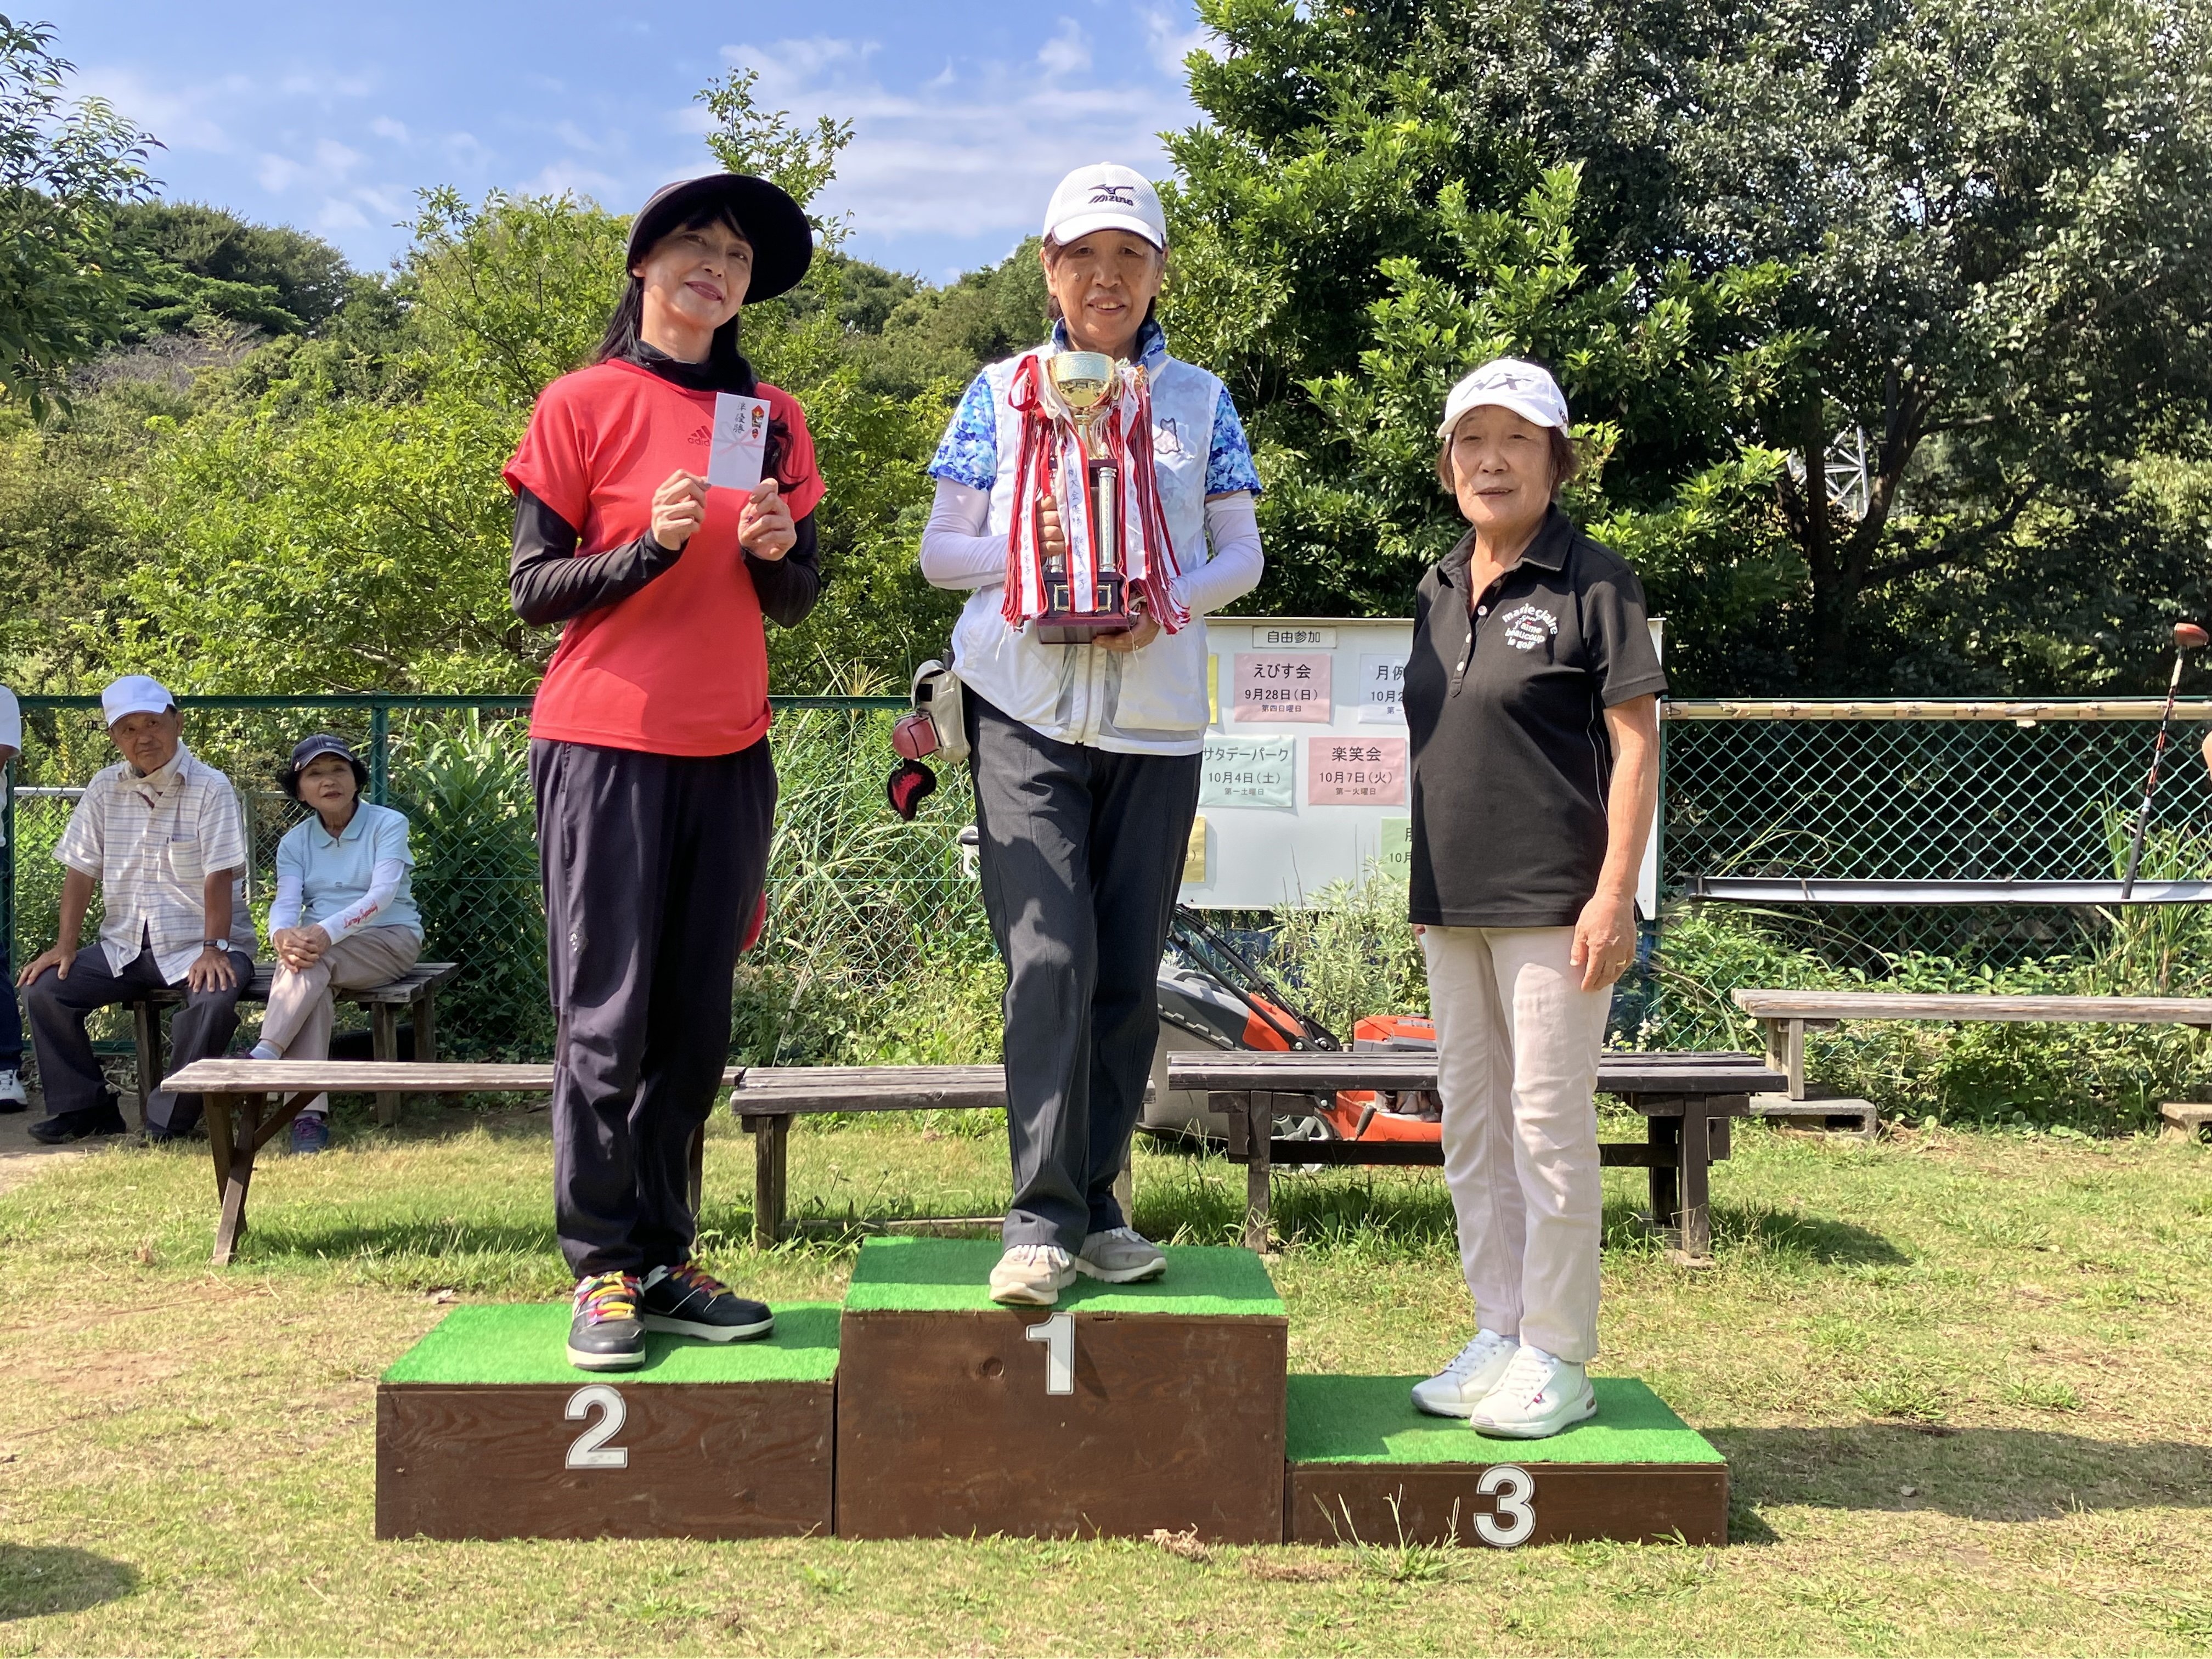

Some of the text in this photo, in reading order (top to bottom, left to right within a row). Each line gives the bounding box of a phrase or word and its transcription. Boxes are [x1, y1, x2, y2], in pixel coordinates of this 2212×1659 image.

[687, 437, 710, 447] adid
[1267, 630, 1321, 644] 自由参加
[1505, 628, 1545, 644] beaucoup
[1516, 640, 1536, 649] golf
[1254, 663, 1311, 679] えびす会
[1244, 689, 1318, 701] 9月28日（日）
[1261, 704, 1302, 713] 第四日曜日
[1203, 747, 1289, 761] サタデーパーク
[1331, 746, 1382, 762] 楽笑会
[1209, 771, 1280, 785] 10月4日（土）
[1319, 772, 1393, 785] 10月7日（火）
[1224, 787, 1264, 795] 第一土曜日
[1335, 787, 1376, 795] 第一火曜日
[1026, 1311, 1076, 1395] 1
[565, 1384, 628, 1470] 2
[1474, 1464, 1536, 1548] 3
